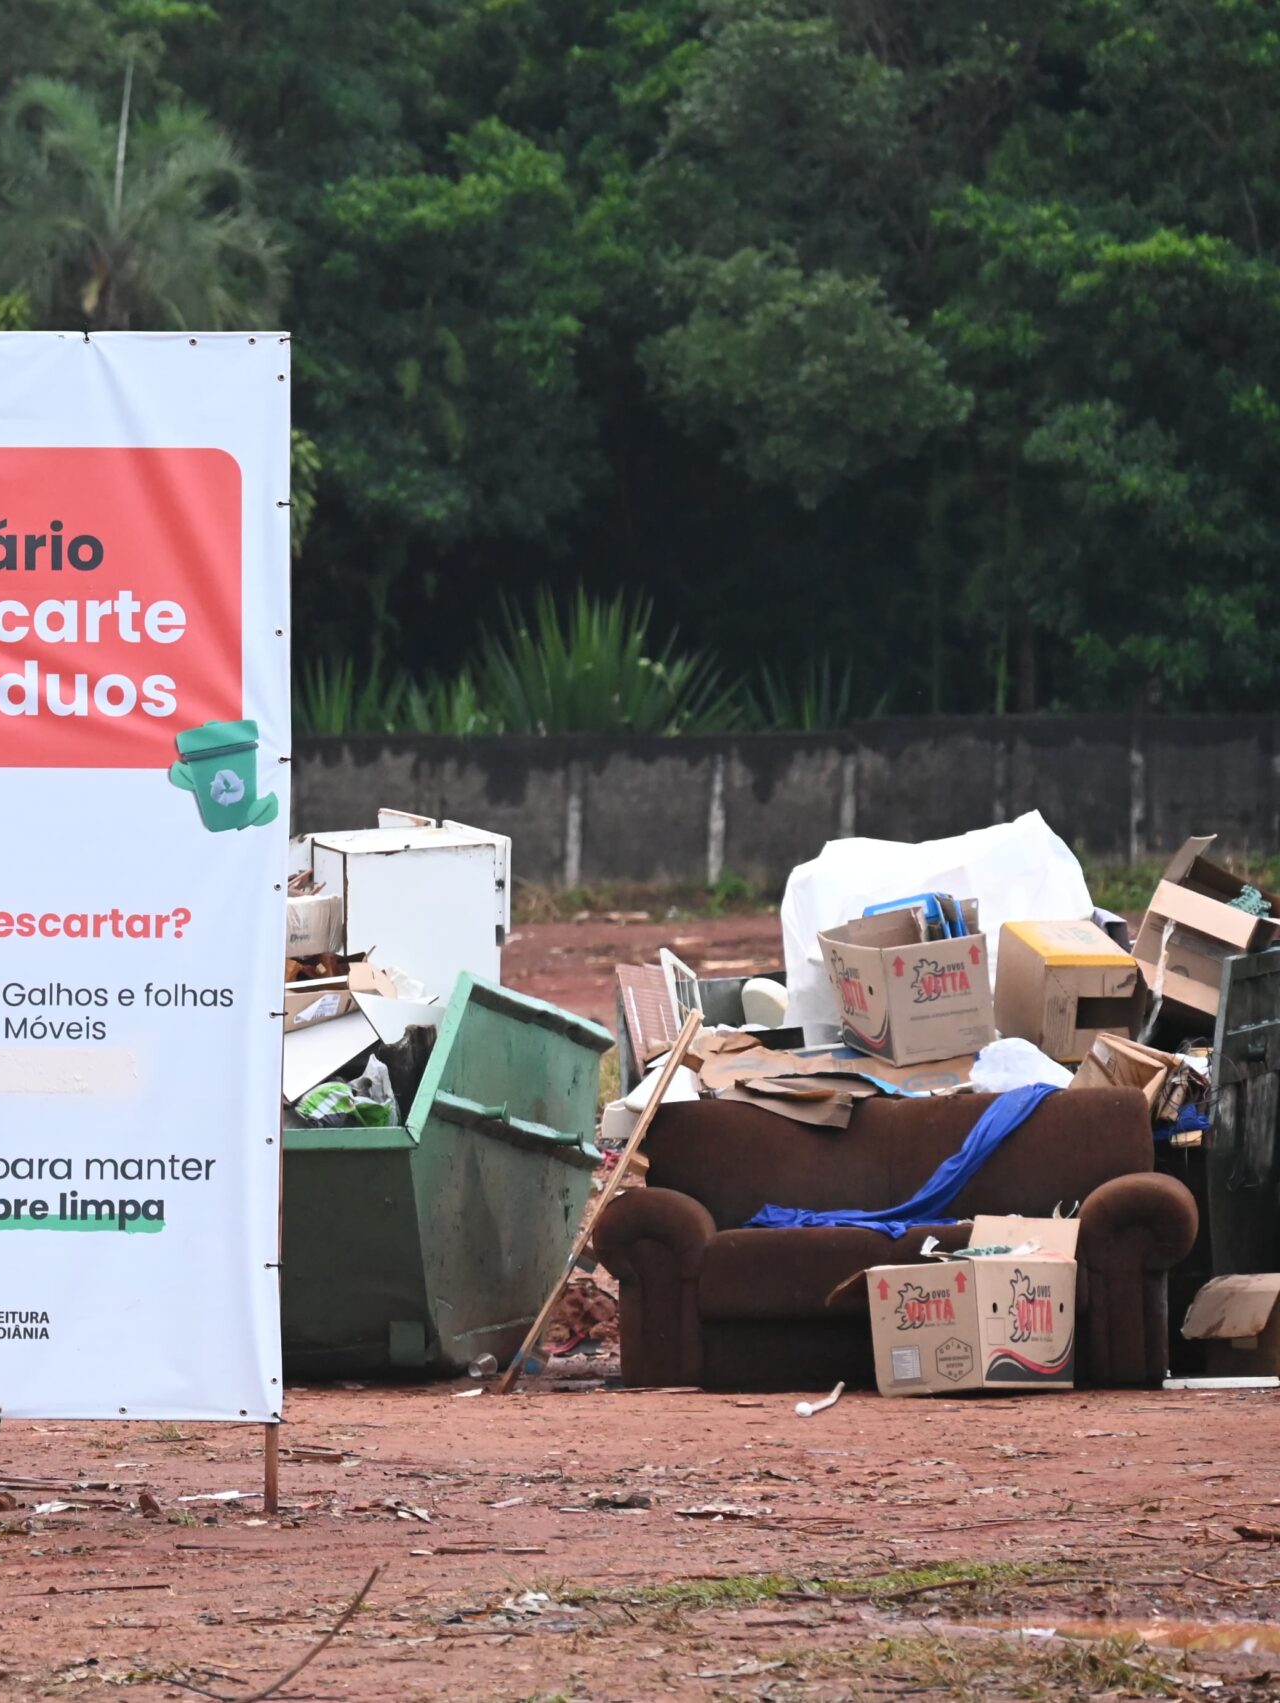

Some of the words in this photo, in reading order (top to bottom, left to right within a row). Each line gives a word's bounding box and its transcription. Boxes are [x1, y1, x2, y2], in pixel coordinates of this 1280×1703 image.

[3, 983, 107, 1006] Galhos
[118, 989, 134, 1006] e
[145, 983, 233, 1007] folhas
[5, 1015, 106, 1040] Móveis
[86, 1155, 215, 1180] manter
[60, 1191, 163, 1230] limpa
[932, 1289, 950, 1299] OVOS
